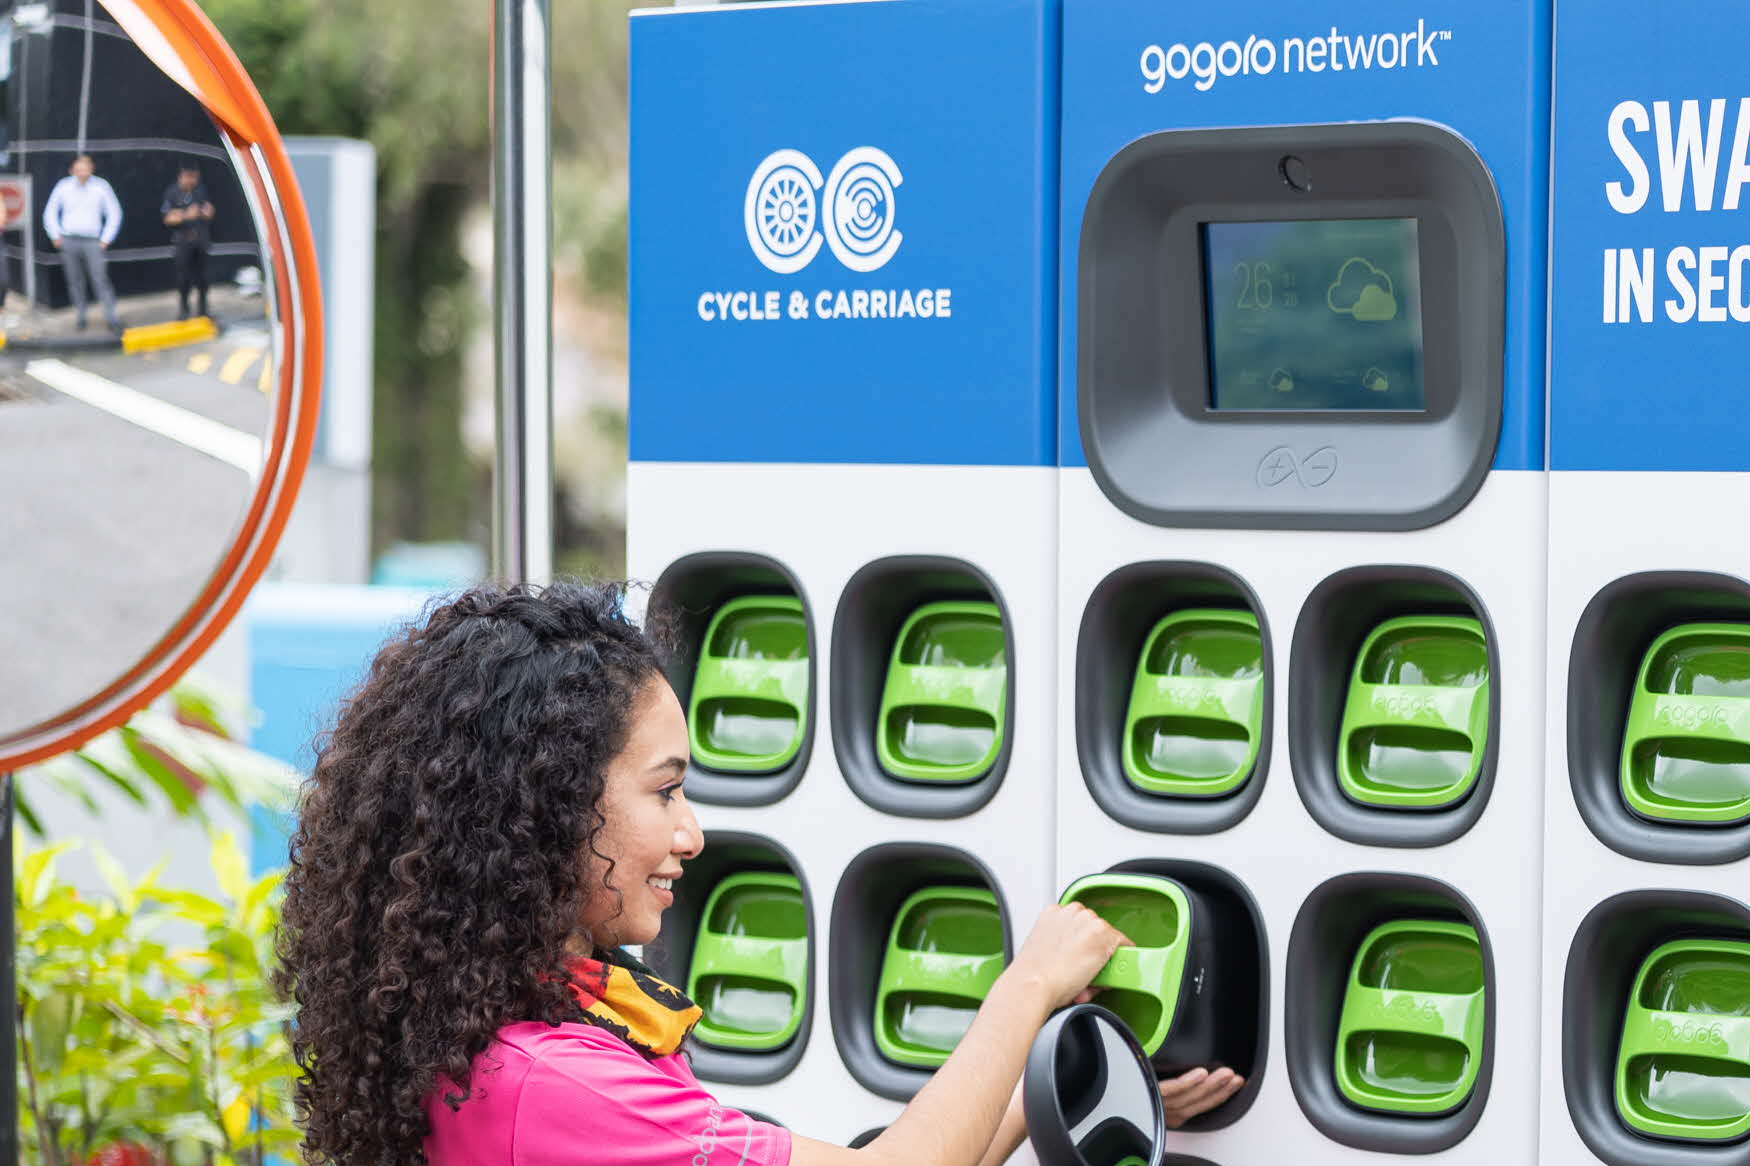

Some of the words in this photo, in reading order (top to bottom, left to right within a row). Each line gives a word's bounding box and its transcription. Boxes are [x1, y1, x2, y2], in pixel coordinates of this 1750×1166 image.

[1140, 34, 1277, 94] gogoro
[697, 291, 781, 321] CYCLE
[788, 290, 809, 320] &
[814, 288, 952, 320] CARRIAGE
[1602, 247, 1655, 324] IN
